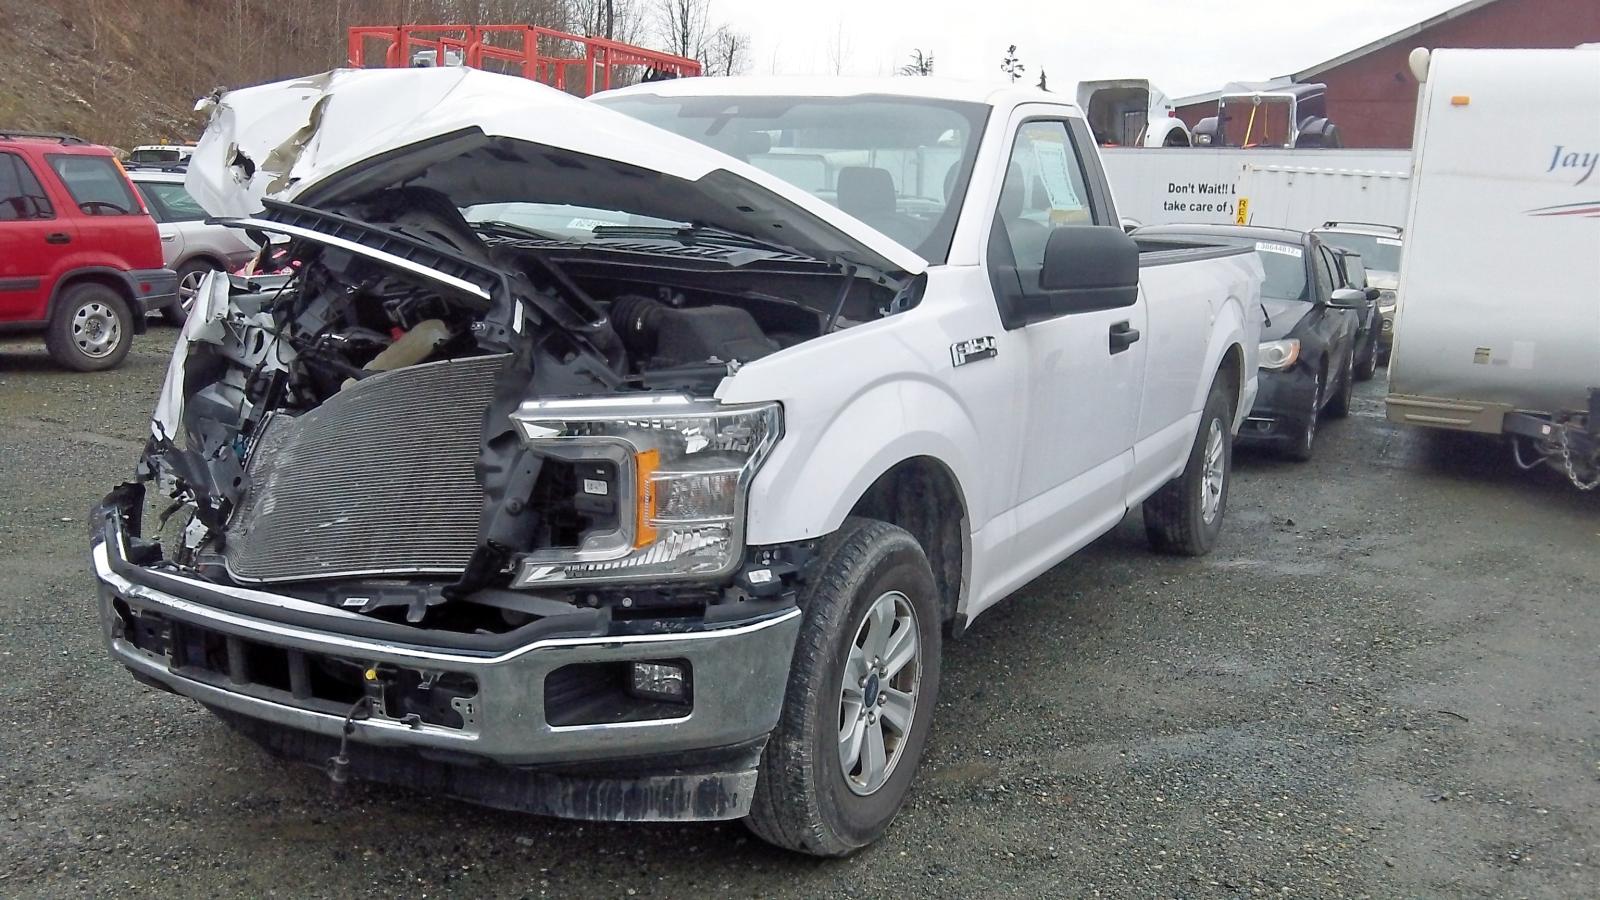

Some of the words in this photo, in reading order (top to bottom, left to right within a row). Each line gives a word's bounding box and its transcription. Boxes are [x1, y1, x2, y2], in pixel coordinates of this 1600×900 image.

[1546, 144, 1600, 187] Jay
[1168, 182, 1195, 194] Don't
[1198, 183, 1228, 194] Wait!!
[1163, 200, 1187, 211] take
[1189, 202, 1213, 212] care
[1216, 201, 1227, 212] of
